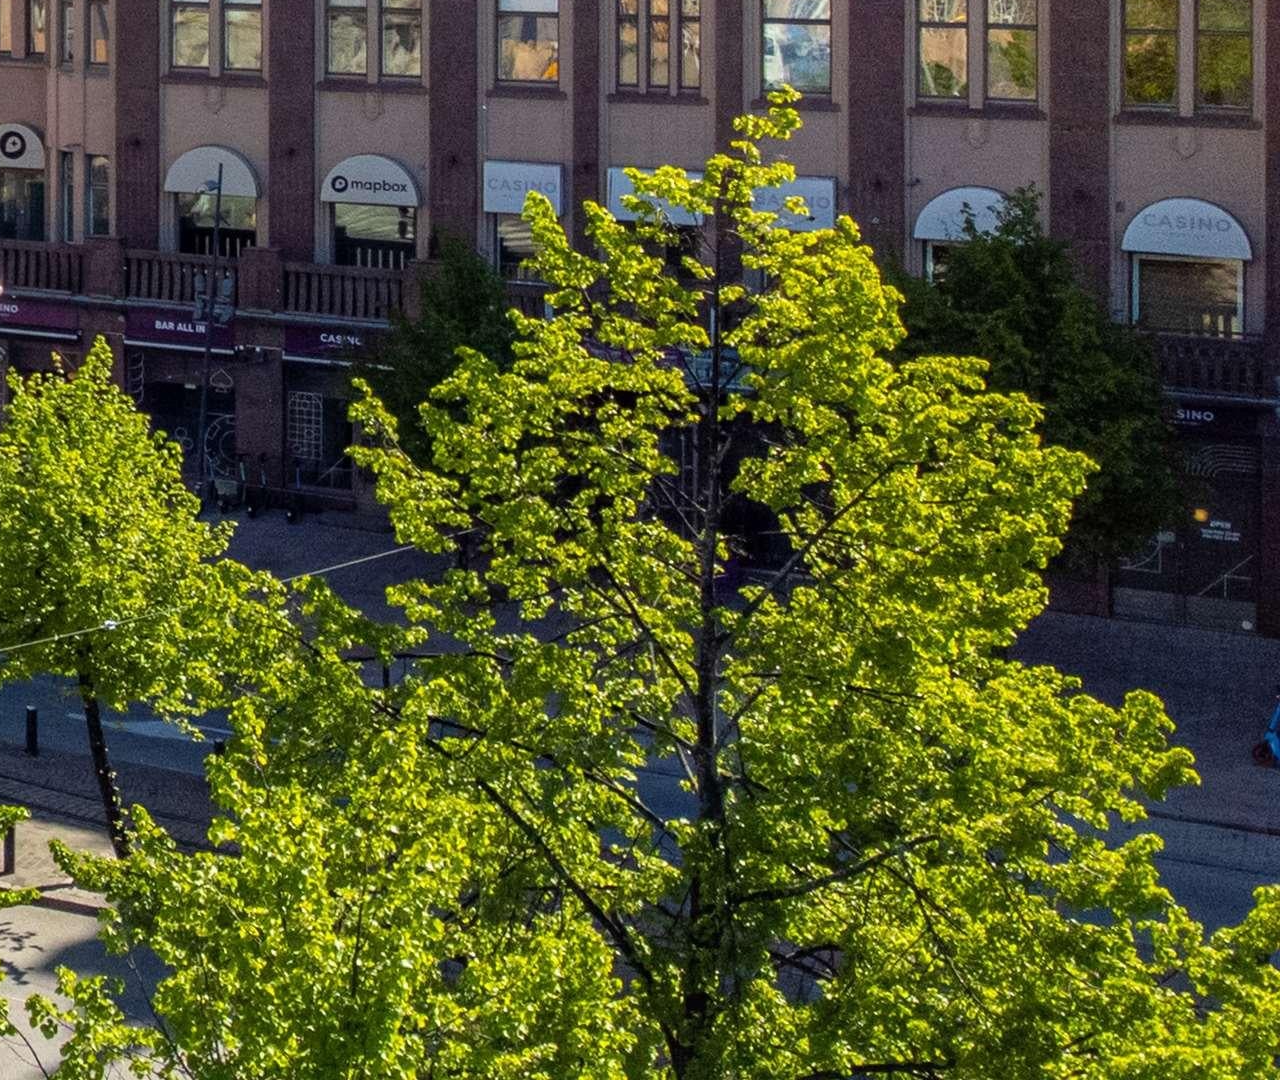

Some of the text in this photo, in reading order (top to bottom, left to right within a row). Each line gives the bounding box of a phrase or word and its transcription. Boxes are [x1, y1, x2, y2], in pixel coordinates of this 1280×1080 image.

[351, 180, 408, 194] mapbox
[488, 177, 557, 193] CASINO
[1143, 213, 1232, 232] CASINO
[155, 320, 206, 334] BAR ALL IN
